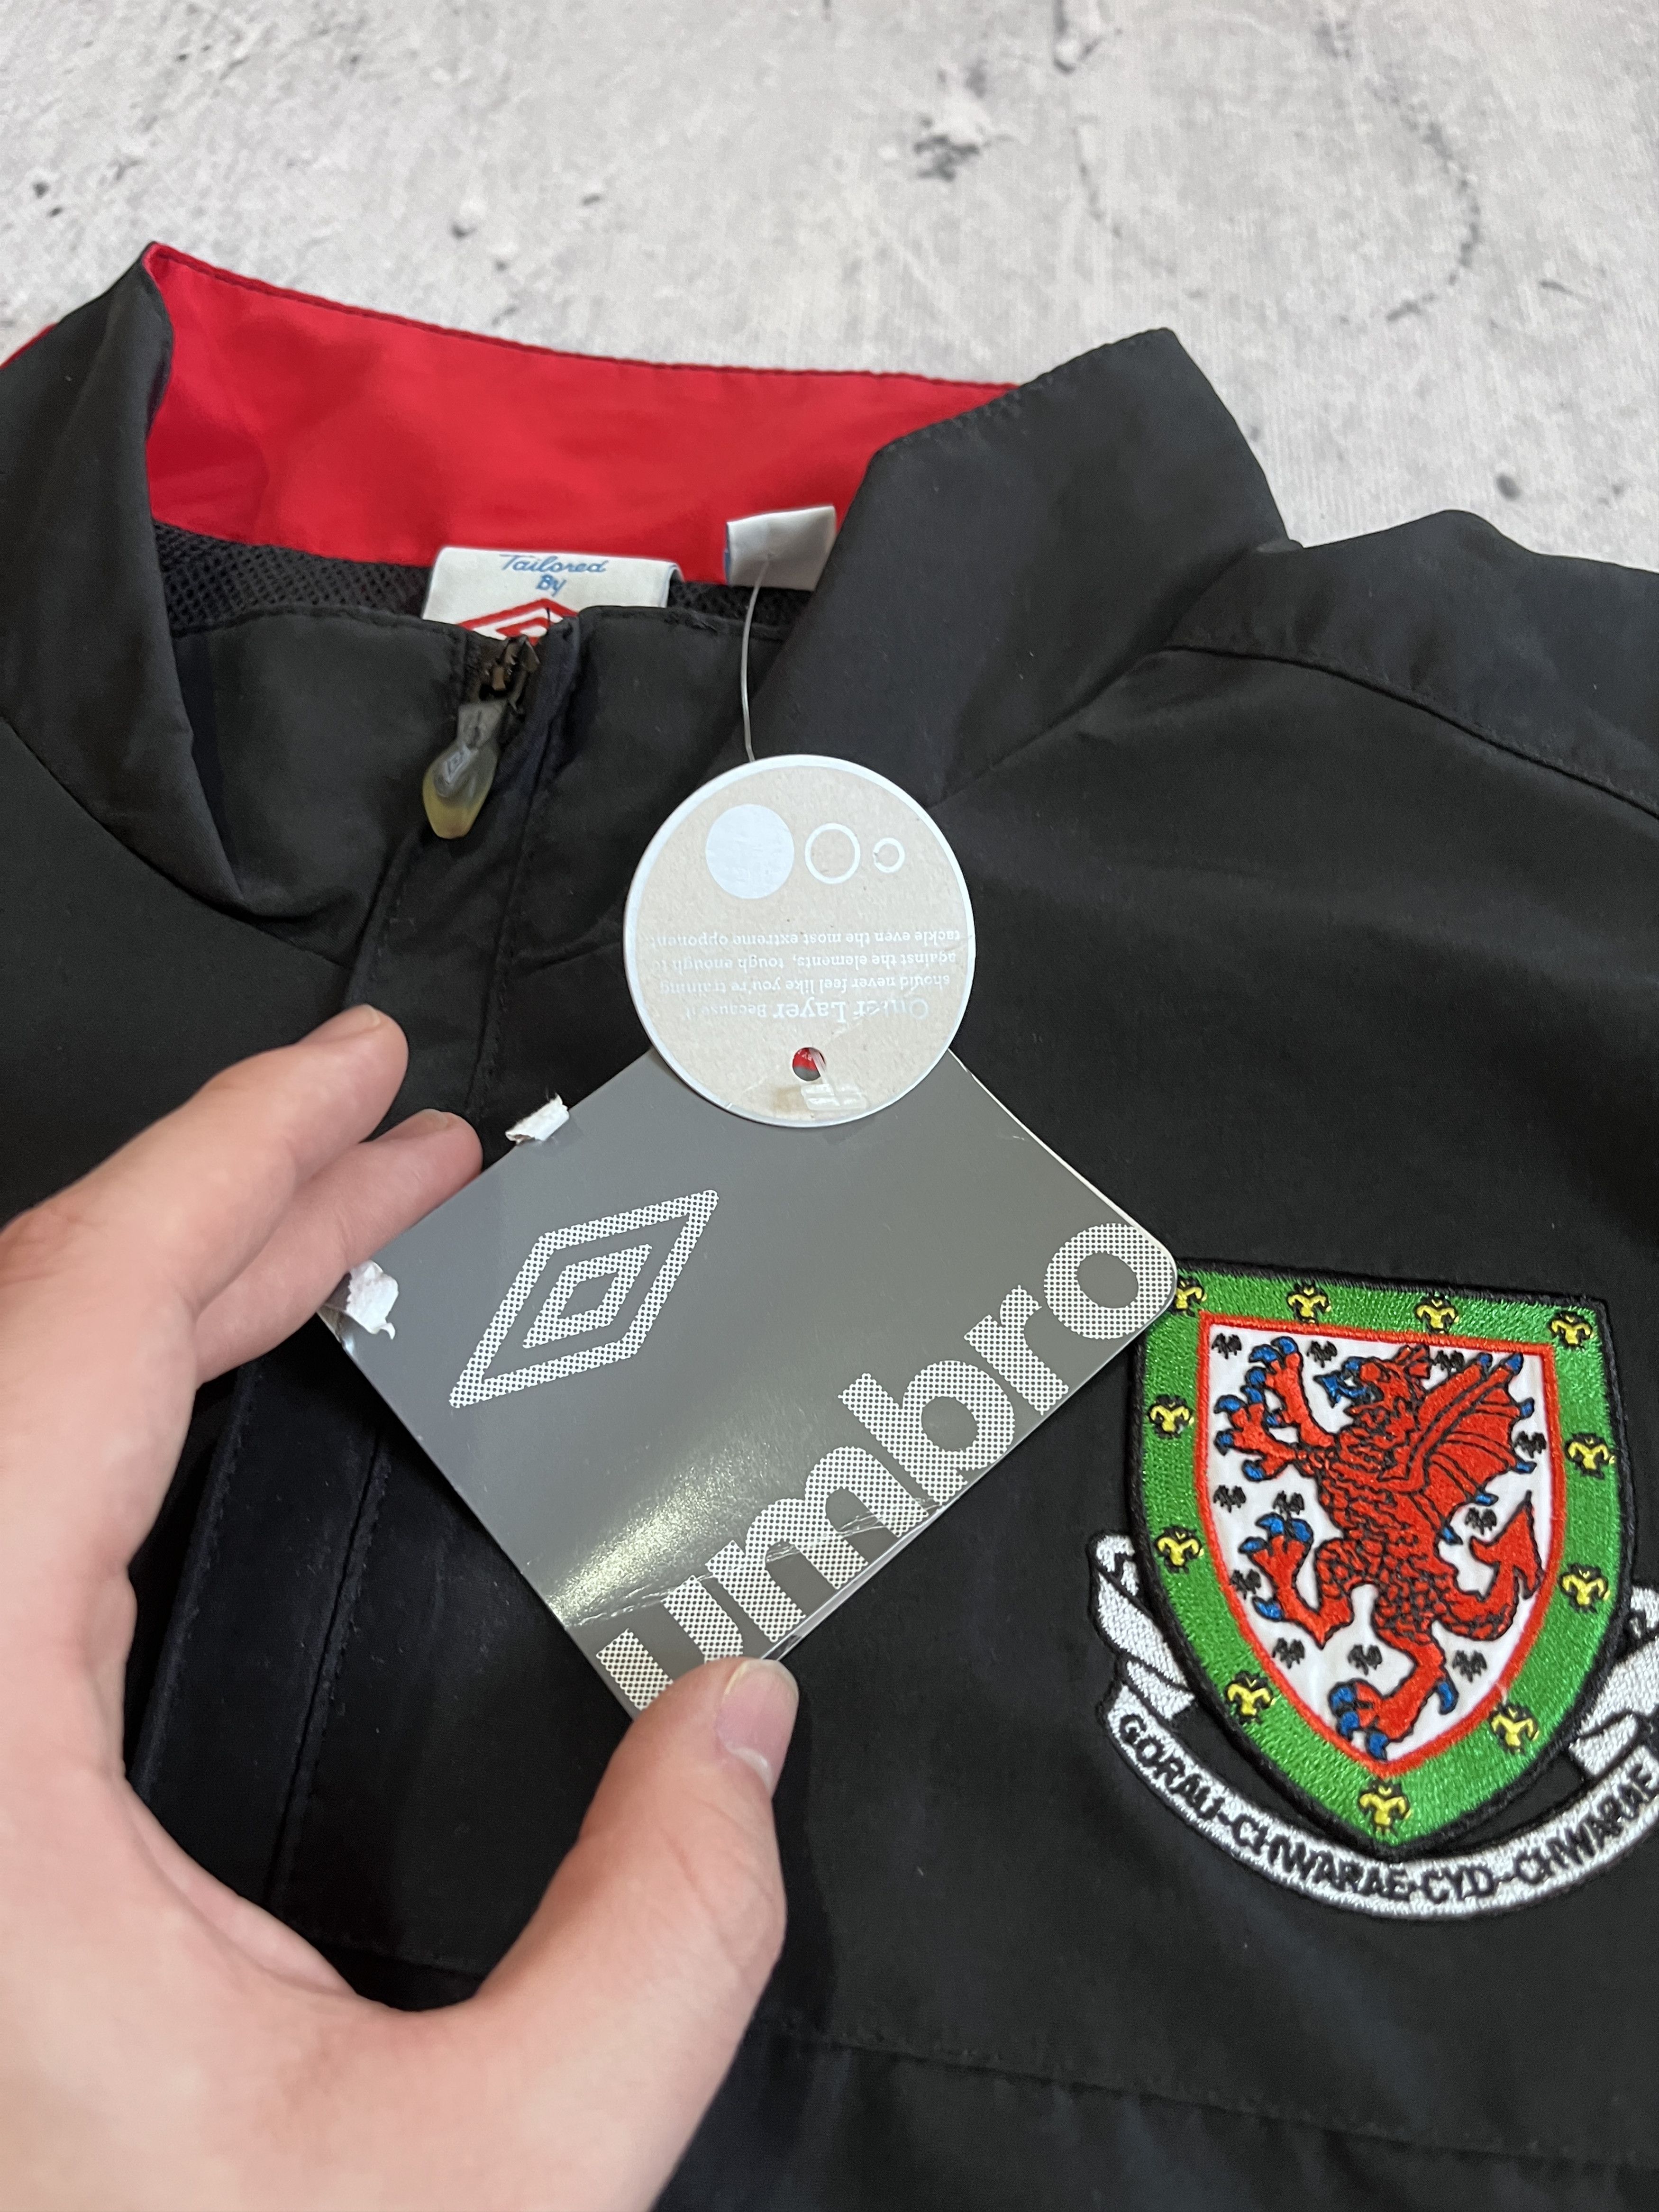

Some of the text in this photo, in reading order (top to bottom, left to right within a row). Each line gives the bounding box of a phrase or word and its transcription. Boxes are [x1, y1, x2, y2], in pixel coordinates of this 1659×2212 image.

[499, 554, 609, 572] Tailored
[536, 574, 566, 597] By
[733, 933, 799, 946] extreme
[803, 933, 842, 946] most
[845, 933, 870, 947] the
[874, 931, 911, 941] even
[914, 930, 960, 946] tackle
[672, 956, 733, 975] enough
[738, 954, 785, 974] tough
[793, 954, 867, 970] elements,
[871, 954, 897, 970] the
[900, 951, 957, 968] against
[659, 975, 950, 995] should never feel like you're training
[701, 1003, 767, 1018] Because
[772, 997, 846, 1023] Layer
[596, 1223, 1174, 1710] umbro
